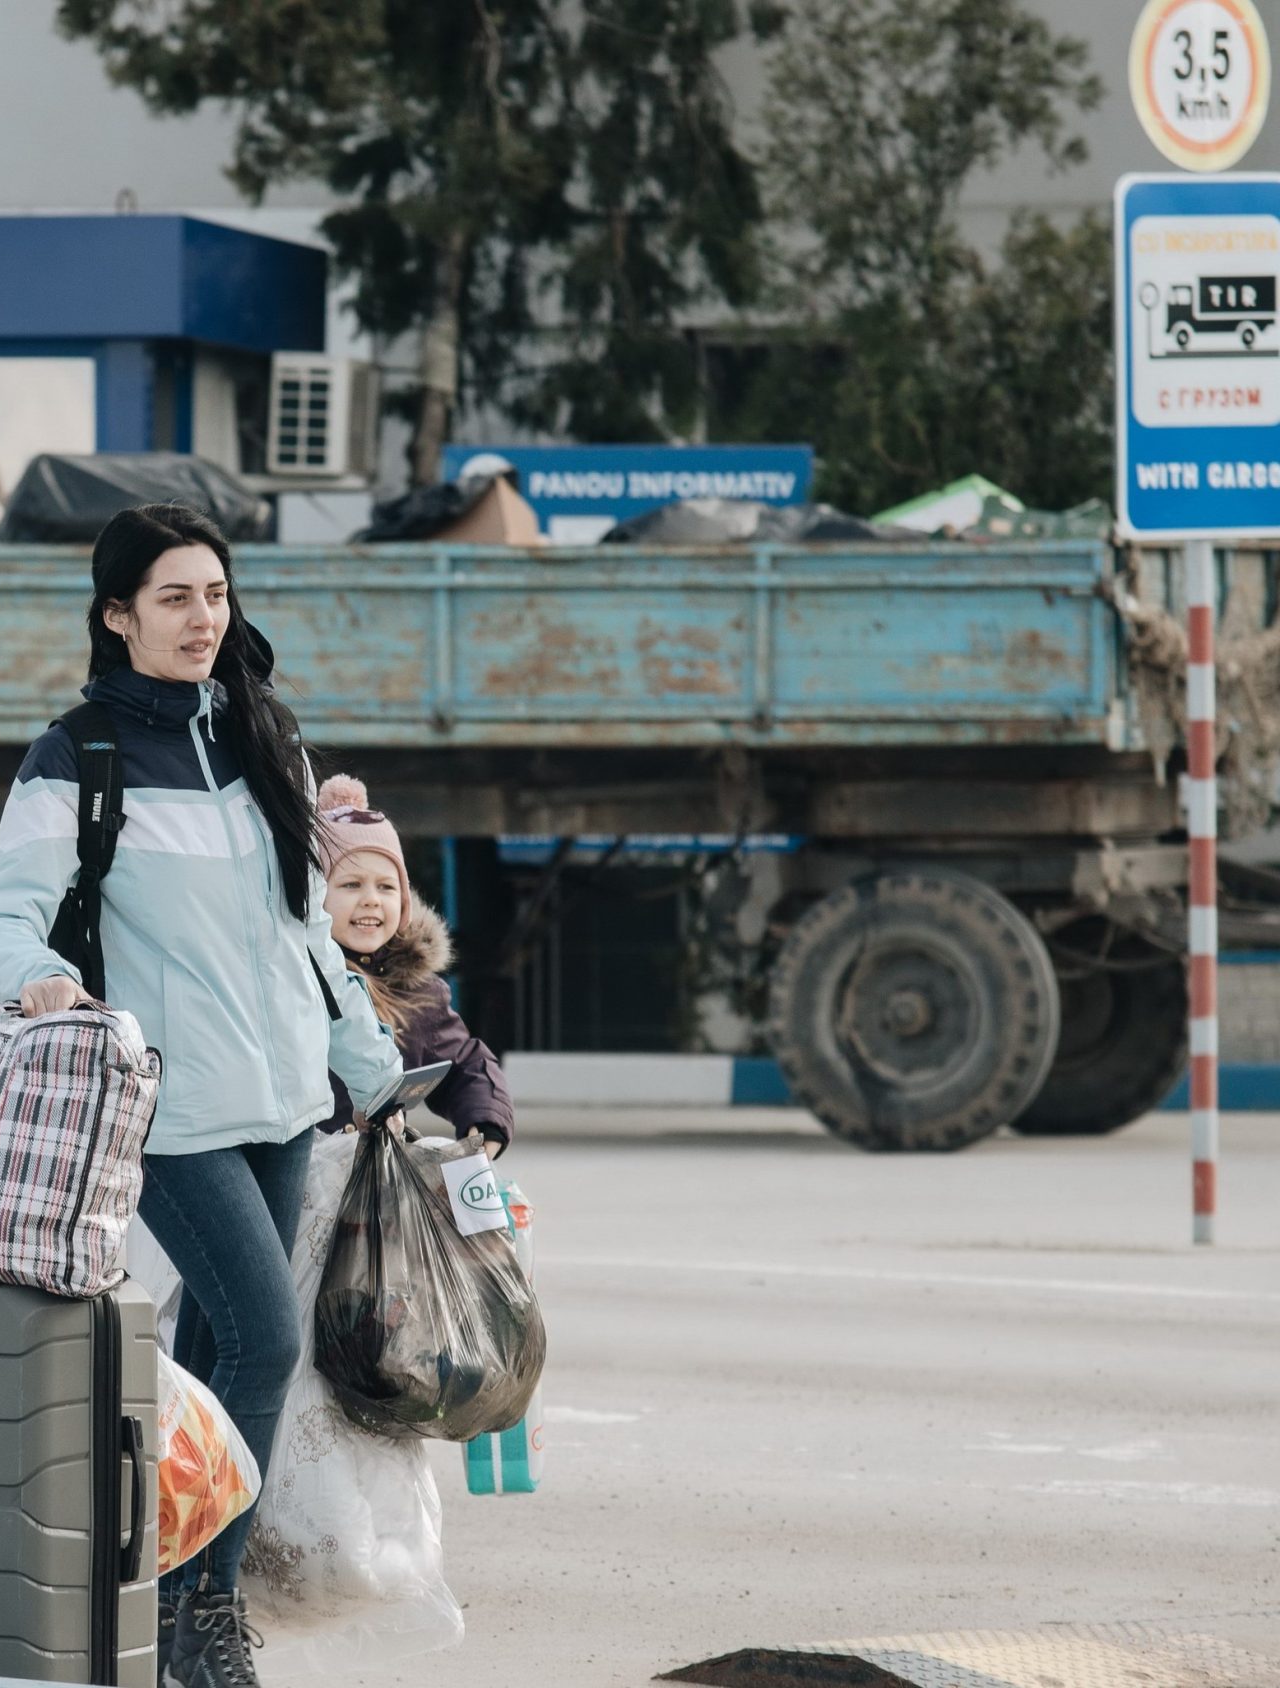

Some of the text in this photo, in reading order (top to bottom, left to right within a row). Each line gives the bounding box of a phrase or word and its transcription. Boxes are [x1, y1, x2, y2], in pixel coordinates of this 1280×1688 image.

[1173, 29, 1231, 91] 3,5
[1208, 285, 1258, 308] TIR
[1179, 385, 1261, 408] ГРУЗОМ
[529, 471, 797, 498] PANOU INFORMATIV
[1135, 461, 1200, 490] WITH
[91, 791, 103, 823] THULE
